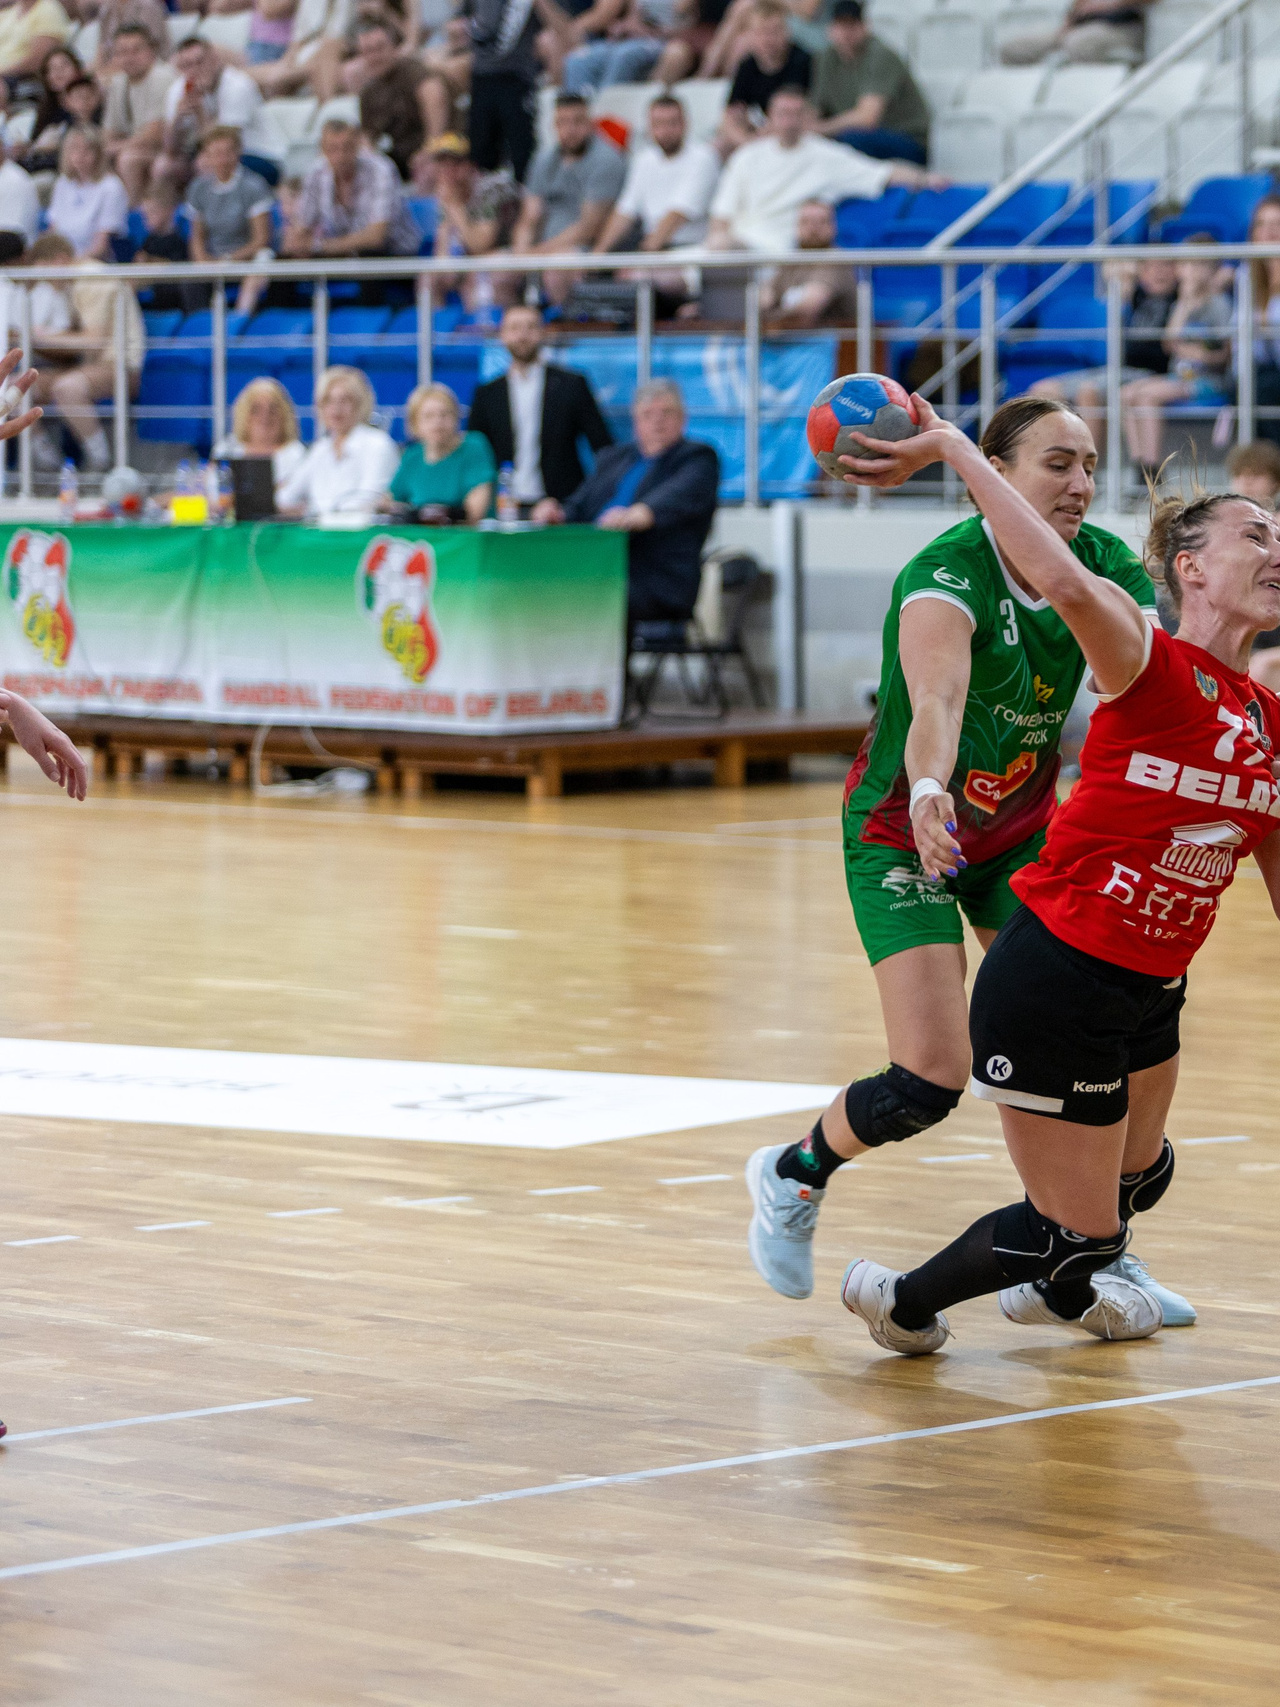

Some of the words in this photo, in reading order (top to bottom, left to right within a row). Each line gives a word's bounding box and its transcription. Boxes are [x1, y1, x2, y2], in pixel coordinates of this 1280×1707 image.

[999, 598, 1020, 646] 3
[463, 691, 499, 718] OF
[1020, 729, 1048, 745] ДСК
[890, 899, 919, 911] ГОРОДА
[1073, 1078, 1121, 1094] Kempa
